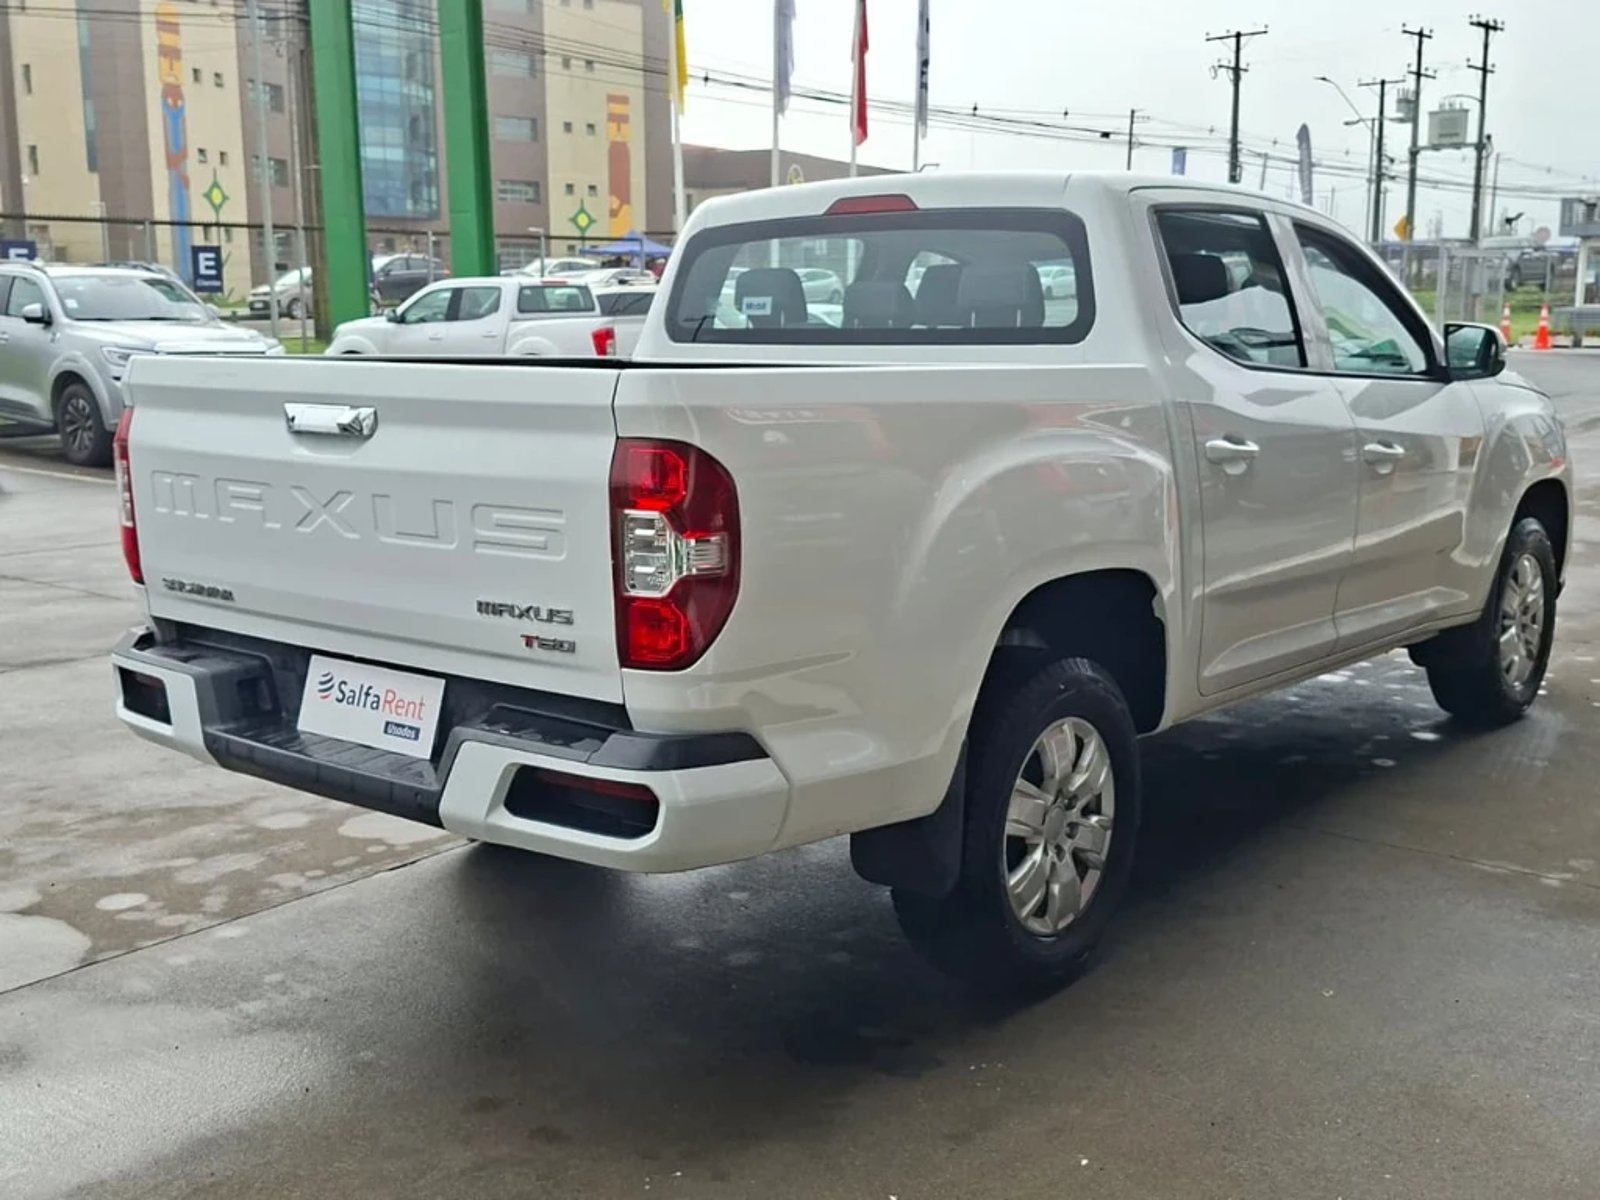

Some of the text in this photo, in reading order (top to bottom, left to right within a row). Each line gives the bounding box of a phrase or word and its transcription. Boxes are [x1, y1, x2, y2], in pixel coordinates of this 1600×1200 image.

[199, 252, 216, 275] E
[151, 470, 567, 561] MAXUS
[476, 600, 574, 625] MAXUS
[520, 634, 576, 654] T60
